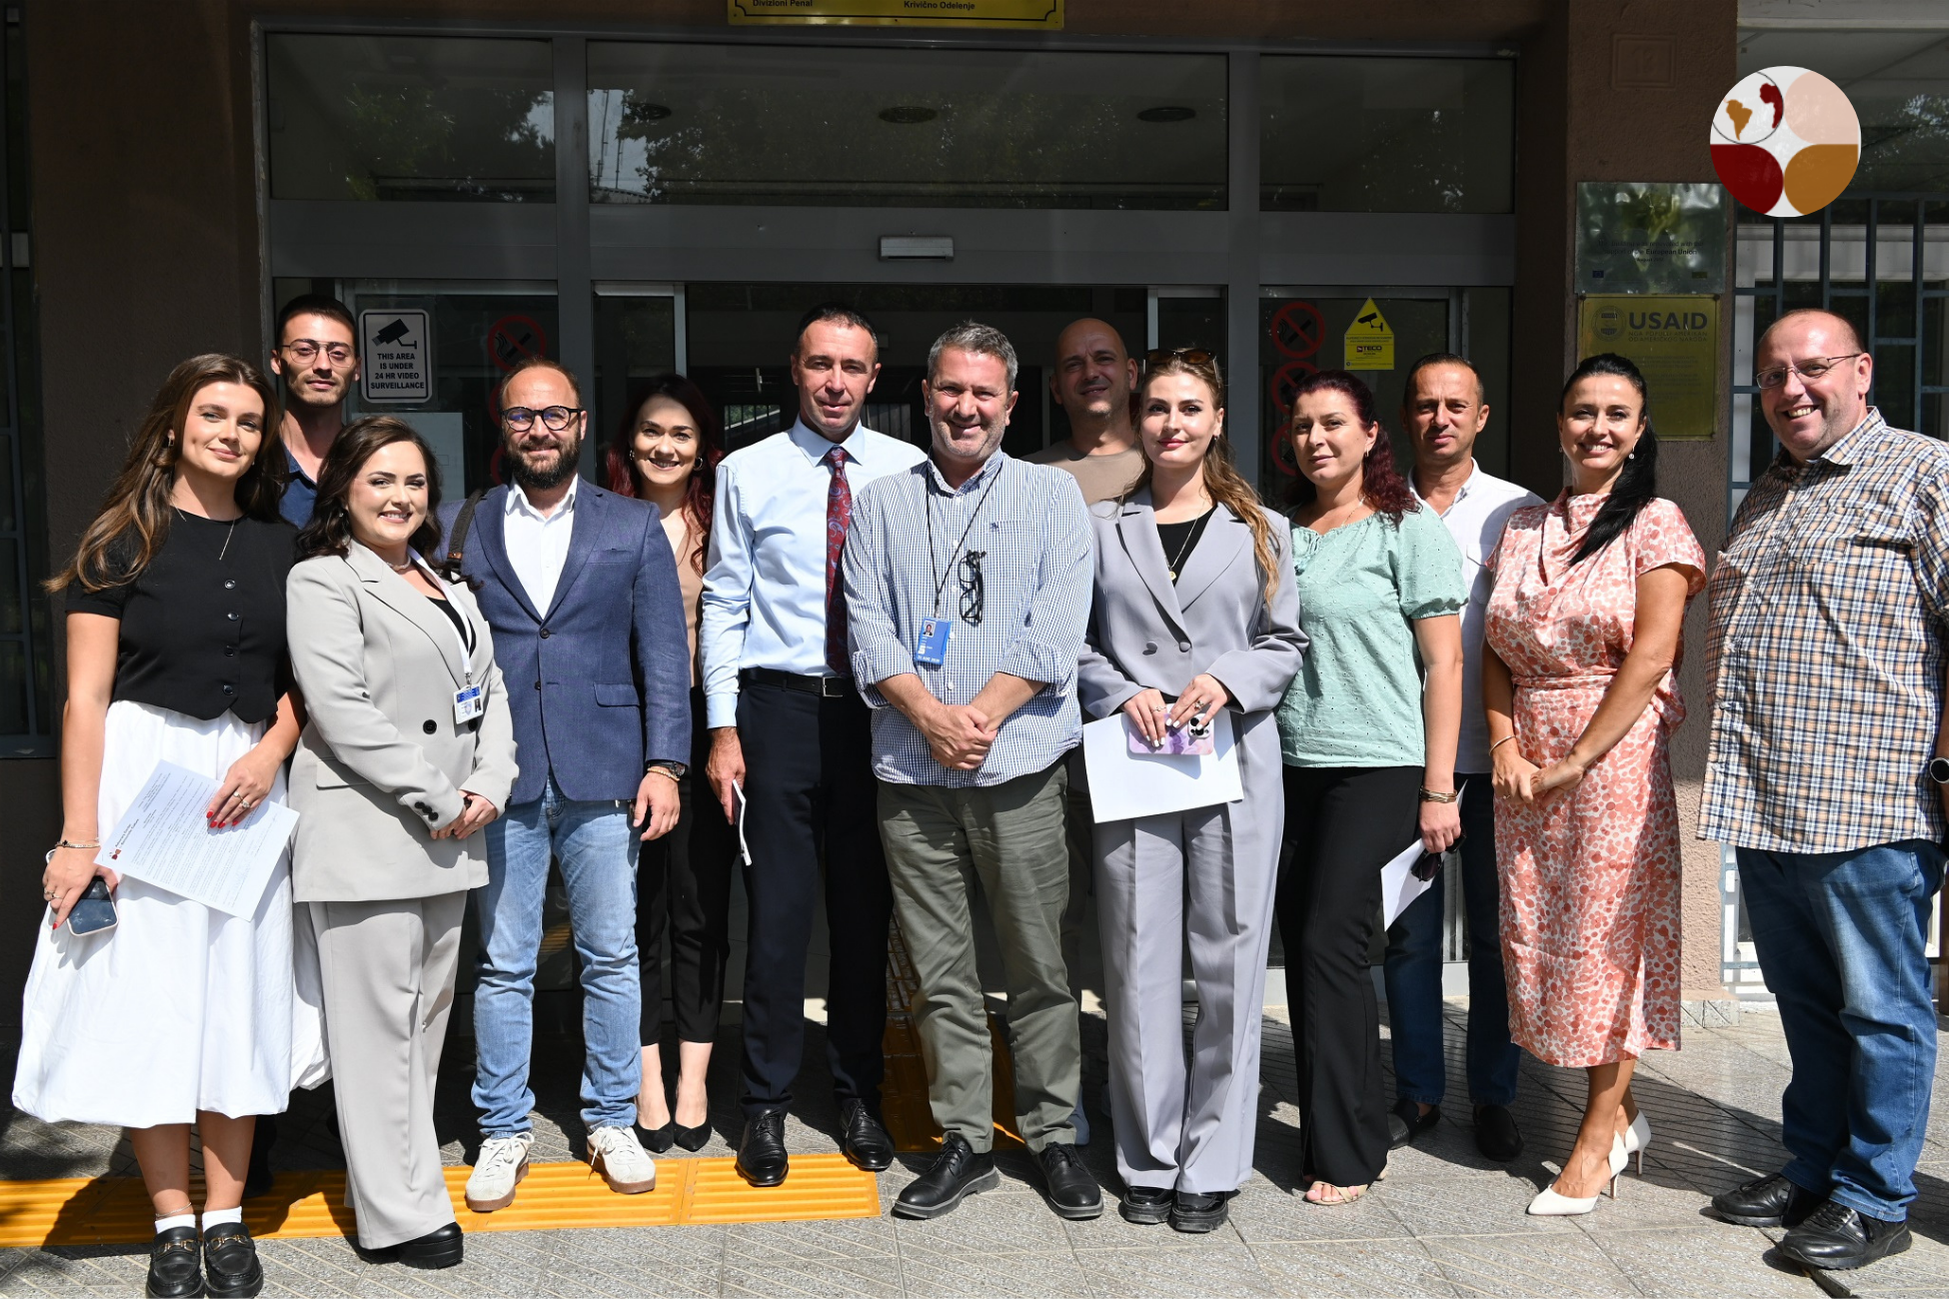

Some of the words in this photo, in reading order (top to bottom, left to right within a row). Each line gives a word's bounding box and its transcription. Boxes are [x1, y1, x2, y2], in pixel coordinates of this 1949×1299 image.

[904, 0, 938, 9] Krivično
[939, 1, 975, 11] Odelenje
[1629, 312, 1708, 330] USAID
